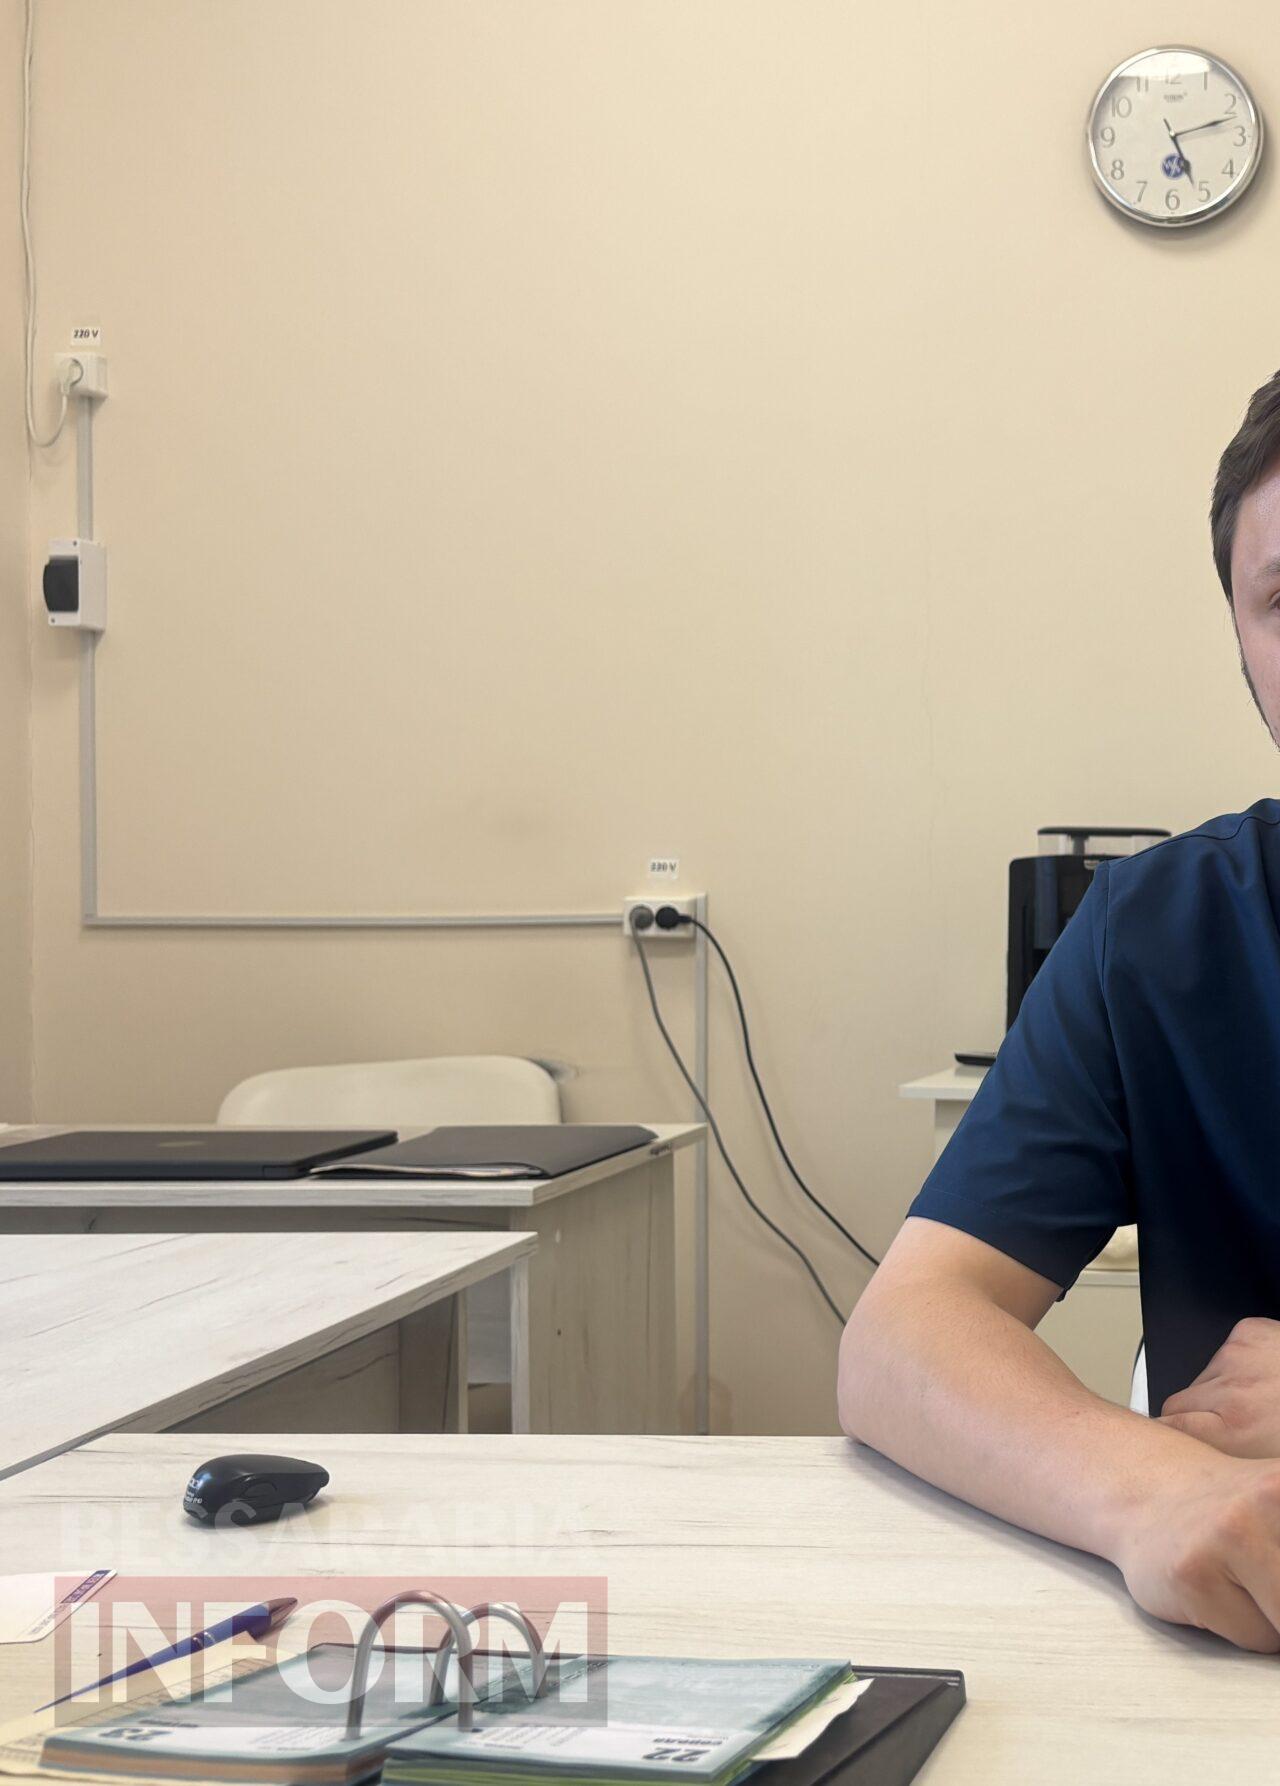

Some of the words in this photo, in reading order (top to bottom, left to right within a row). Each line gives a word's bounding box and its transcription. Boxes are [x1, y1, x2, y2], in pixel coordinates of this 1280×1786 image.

[1111, 96, 1132, 118] 10
[1224, 94, 1238, 115] 2
[1100, 127, 1116, 149] 9
[1233, 126, 1247, 147] 3
[1110, 159, 1125, 181] 8
[1221, 159, 1235, 179] 4
[1135, 181, 1148, 203] 7
[1165, 188, 1181, 211] 6
[1198, 181, 1212, 203] 5
[73, 329, 90, 338] 220
[91, 329, 99, 338] V
[669, 862, 677, 872] V
[641, 1747, 711, 1763] 22
